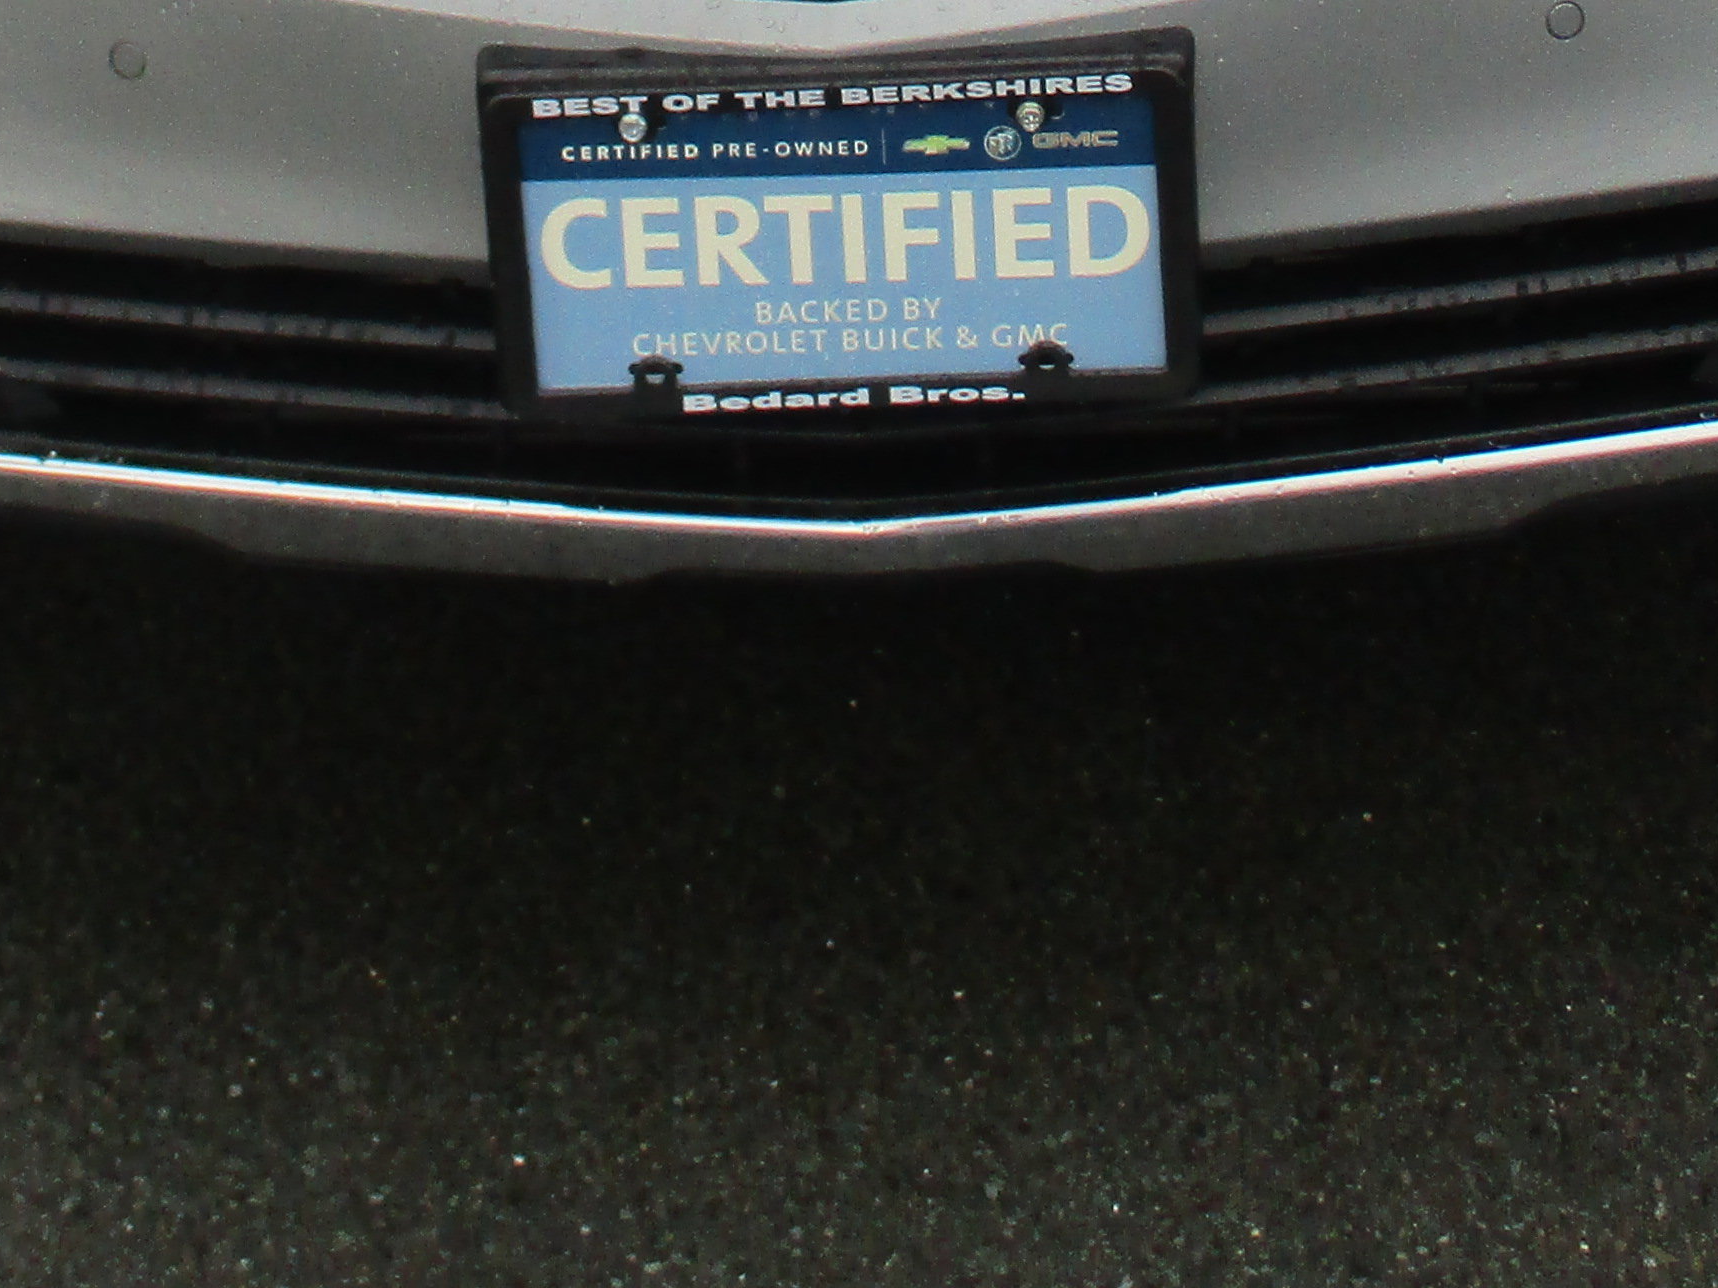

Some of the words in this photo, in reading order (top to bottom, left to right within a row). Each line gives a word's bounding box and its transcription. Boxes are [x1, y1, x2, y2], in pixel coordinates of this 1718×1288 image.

[532, 96, 649, 119] BEST
[662, 93, 721, 114] OF
[734, 89, 826, 110] THE
[840, 74, 1134, 107] BERKSHIRES
[561, 143, 699, 162] CERTIFIED
[713, 139, 869, 159] PRE-OWNED
[1032, 130, 1119, 150] GMC
[540, 184, 1151, 290] CERTIFIED
[755, 298, 888, 324] BACKED
[903, 296, 943, 322] BY
[632, 329, 827, 357] CHEVROLET
[842, 327, 943, 352] BUICK
[956, 325, 979, 348] &
[991, 323, 1069, 348] GMC
[683, 388, 870, 414] Bedard
[889, 385, 1026, 406] Bros.
